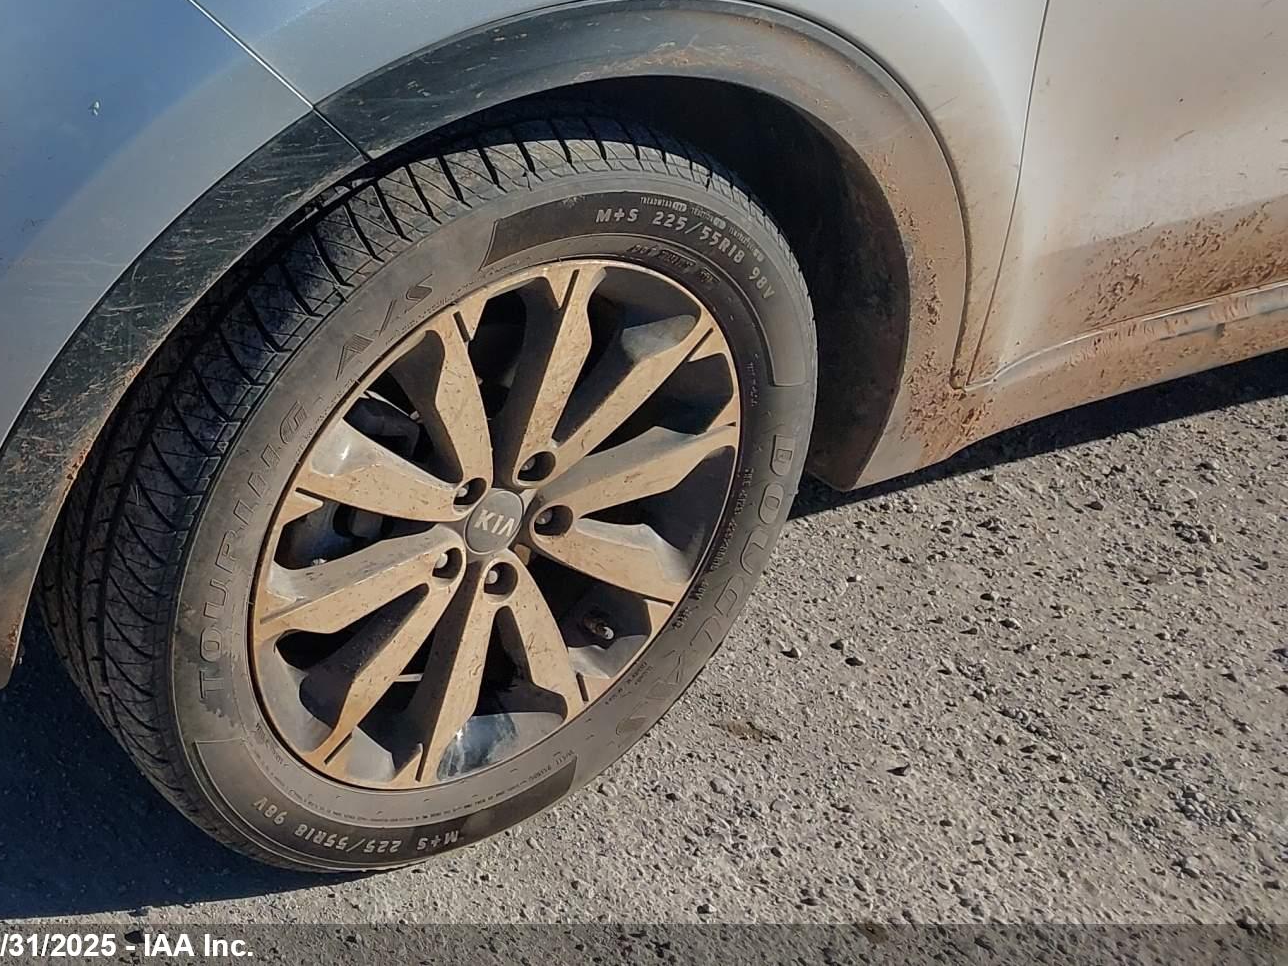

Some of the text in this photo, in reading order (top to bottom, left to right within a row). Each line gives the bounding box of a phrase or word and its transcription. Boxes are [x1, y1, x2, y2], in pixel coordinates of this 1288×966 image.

[595, 208, 639, 224] M+S
[652, 211, 745, 265] 225/55R18
[748, 267, 775, 299] 98V
[474, 509, 515, 538] KIA
[252, 796, 288, 826] 98V
[293, 824, 401, 855] 225/55R18
[416, 829, 461, 852] M+S
